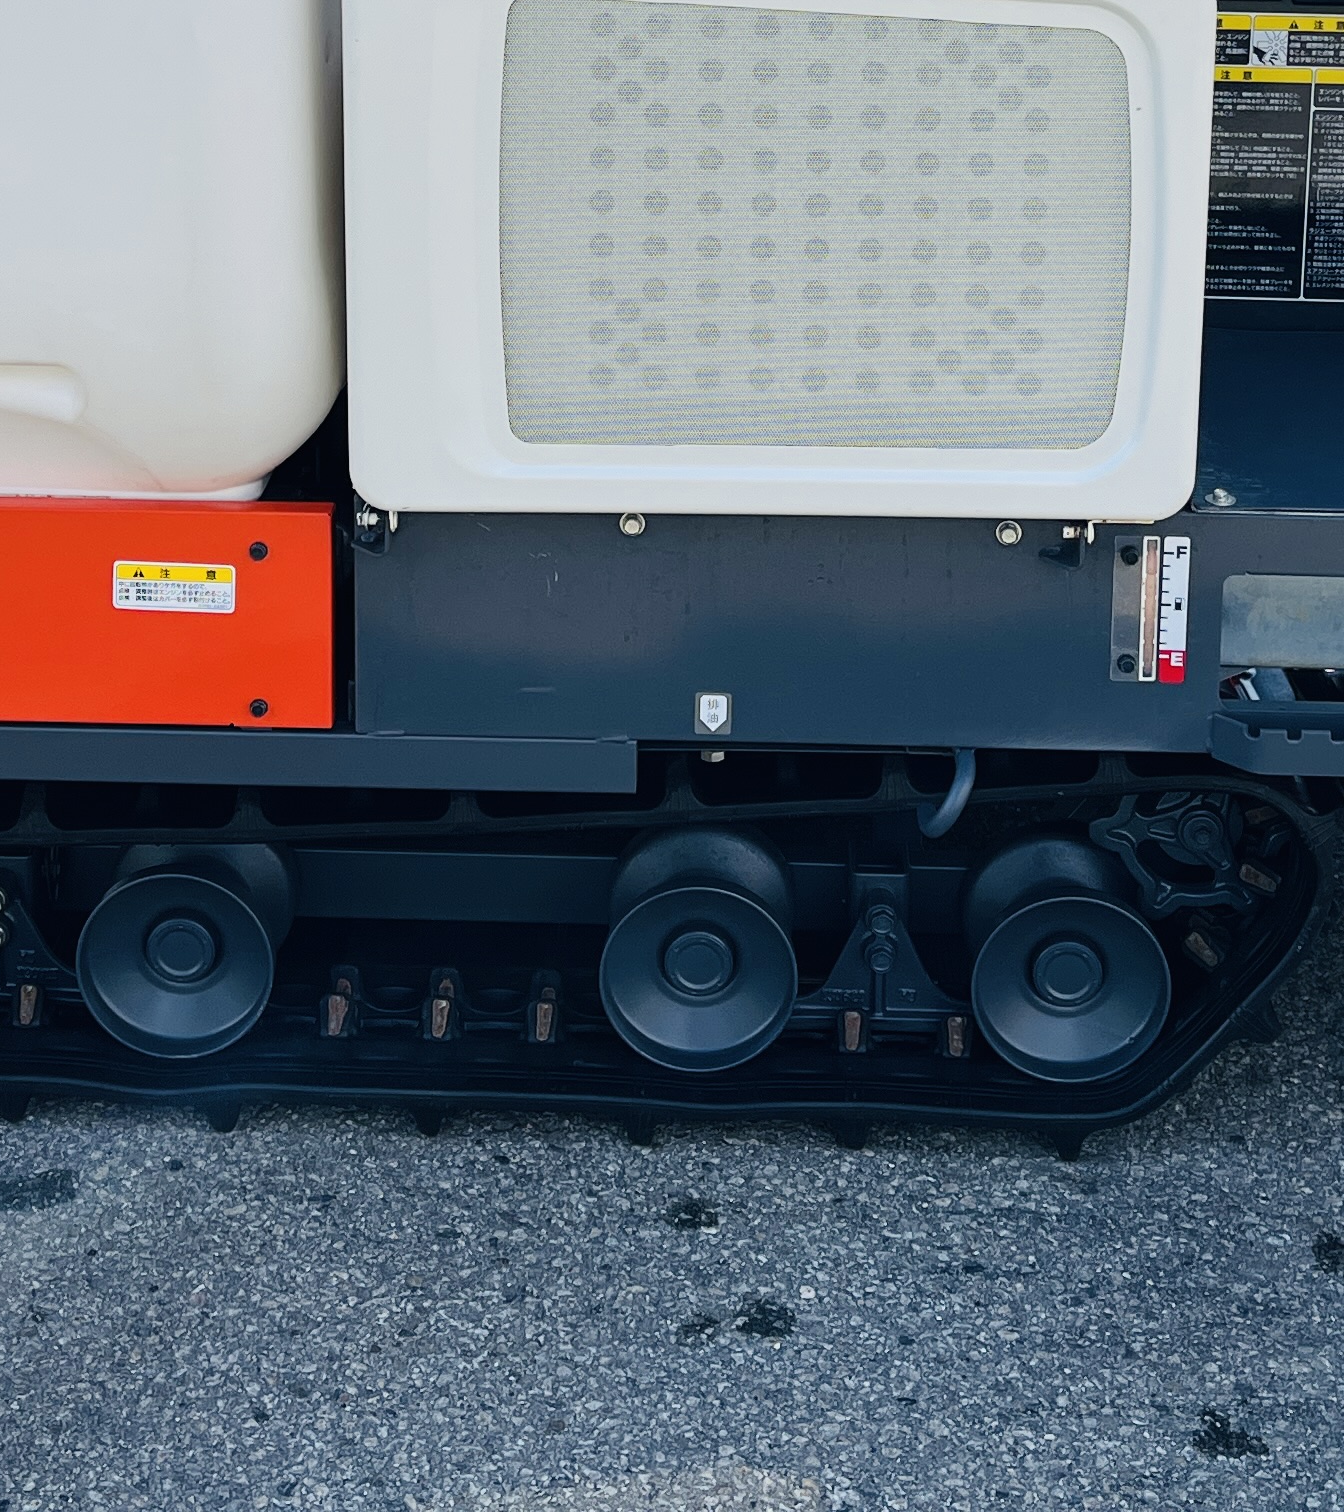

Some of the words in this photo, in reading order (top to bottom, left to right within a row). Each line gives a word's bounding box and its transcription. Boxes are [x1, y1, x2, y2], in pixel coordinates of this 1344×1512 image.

[1176, 546, 1188, 559] F
[159, 568, 217, 581] 注意
[1170, 651, 1184, 667] E
[707, 698, 719, 724] 排油
